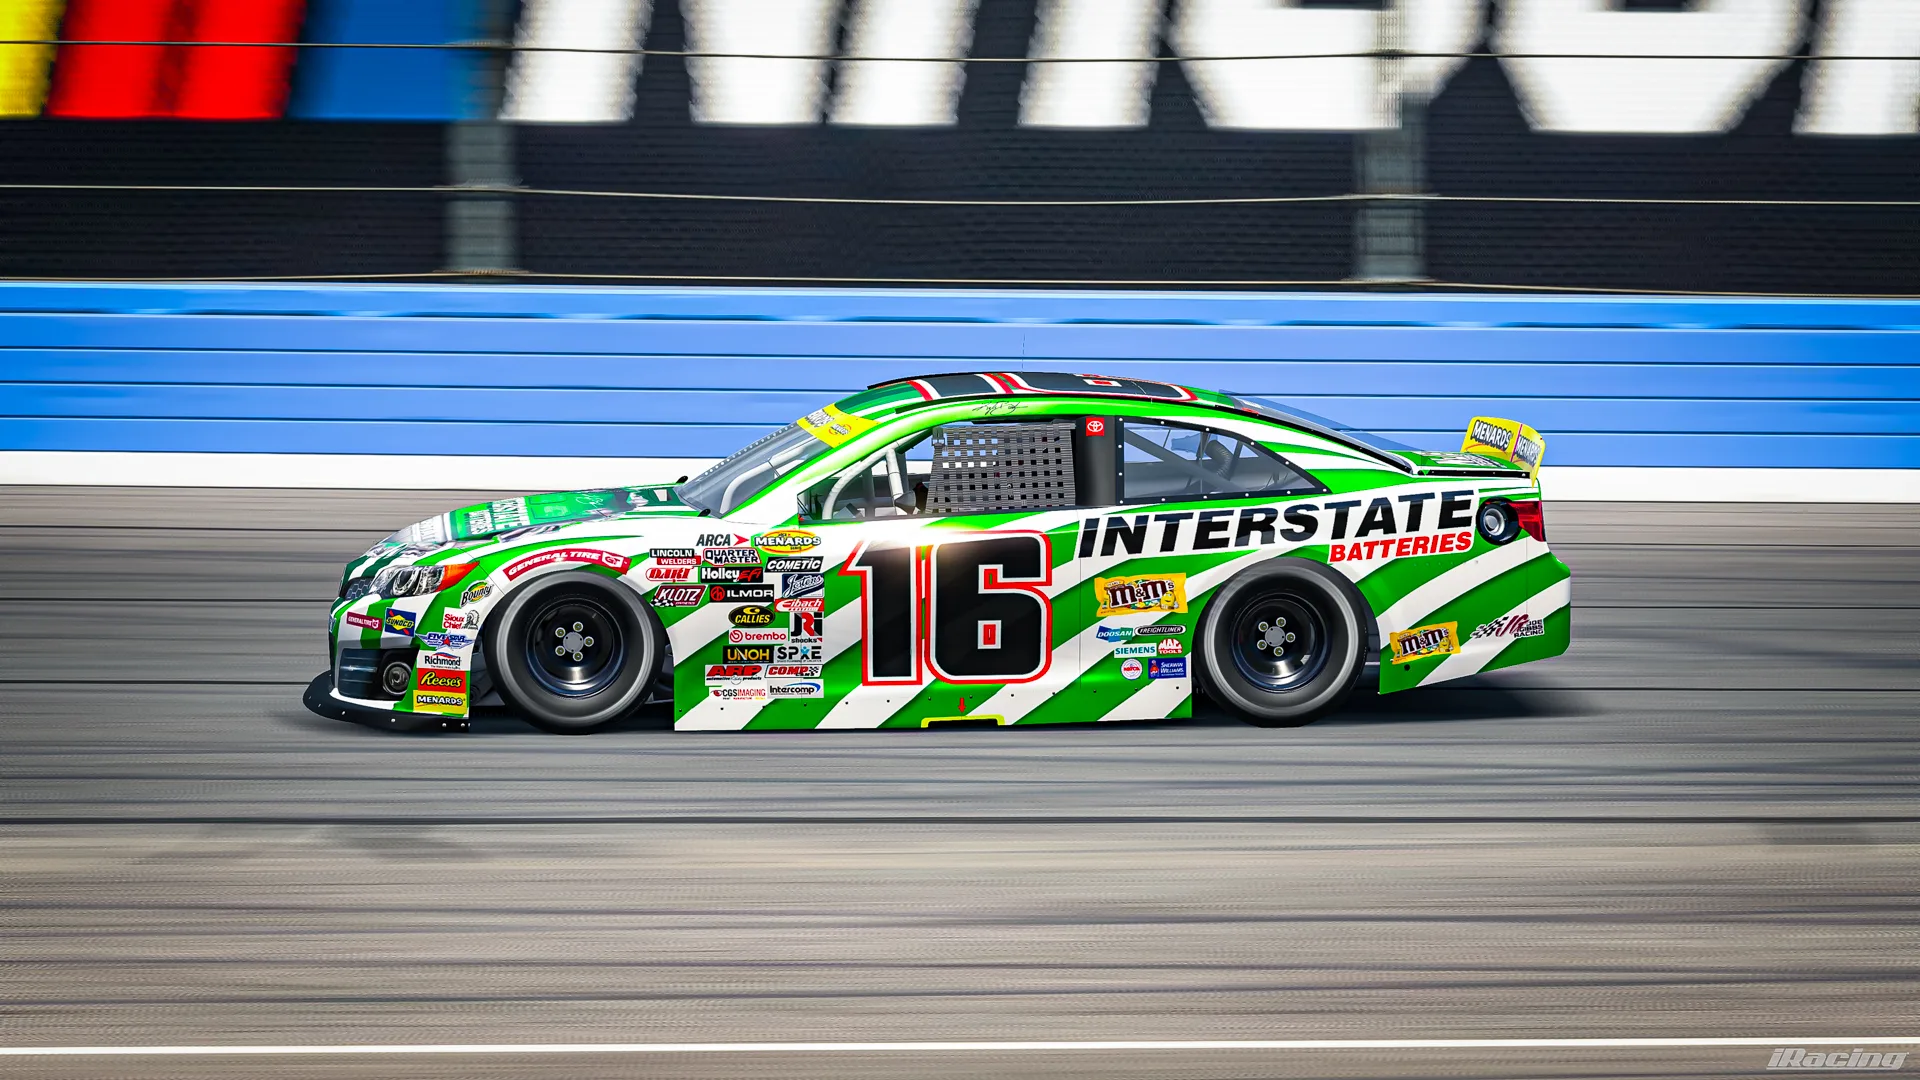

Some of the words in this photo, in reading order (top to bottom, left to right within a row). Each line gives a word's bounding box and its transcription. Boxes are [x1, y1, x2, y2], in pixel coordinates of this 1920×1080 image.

[1470, 420, 1512, 451] MENARDS
[1077, 490, 1474, 558] INTERSTATE
[695, 533, 731, 547] ARCA
[754, 536, 822, 546] MENARDS
[1329, 531, 1472, 562] BATTERIES
[651, 549, 693, 557] LINCOLN
[705, 549, 756, 560] QUARTER
[508, 551, 568, 576] GENERAL
[569, 551, 601, 561] TIRE
[714, 556, 758, 564] MASTER
[767, 557, 821, 570] COMETIC
[701, 567, 740, 582] Holley
[461, 585, 494, 606] Bounty
[658, 588, 702, 602] KLOTZ
[726, 589, 774, 598] ILMOR
[776, 599, 822, 612] Eibach
[838, 530, 1052, 686] 16
[386, 617, 414, 628] SUNOCO
[444, 613, 465, 622] Sioux
[735, 614, 771, 624] CALLIES
[443, 621, 463, 629] Chief
[1140, 626, 1182, 634] FREIGHTLINER
[1519, 624, 1543, 632] GIBBS
[745, 631, 787, 640] brembo
[1098, 630, 1132, 638] DOOSAN
[1513, 630, 1544, 638] RACING
[727, 648, 770, 661] UNOH
[1115, 646, 1156, 655] SIEMENS
[424, 655, 461, 666] Richmond
[706, 665, 762, 677] ARP
[768, 666, 809, 676] COMP
[420, 671, 462, 687] Reese's
[770, 685, 815, 695] Intercomp
[417, 695, 463, 705] MENARDS
